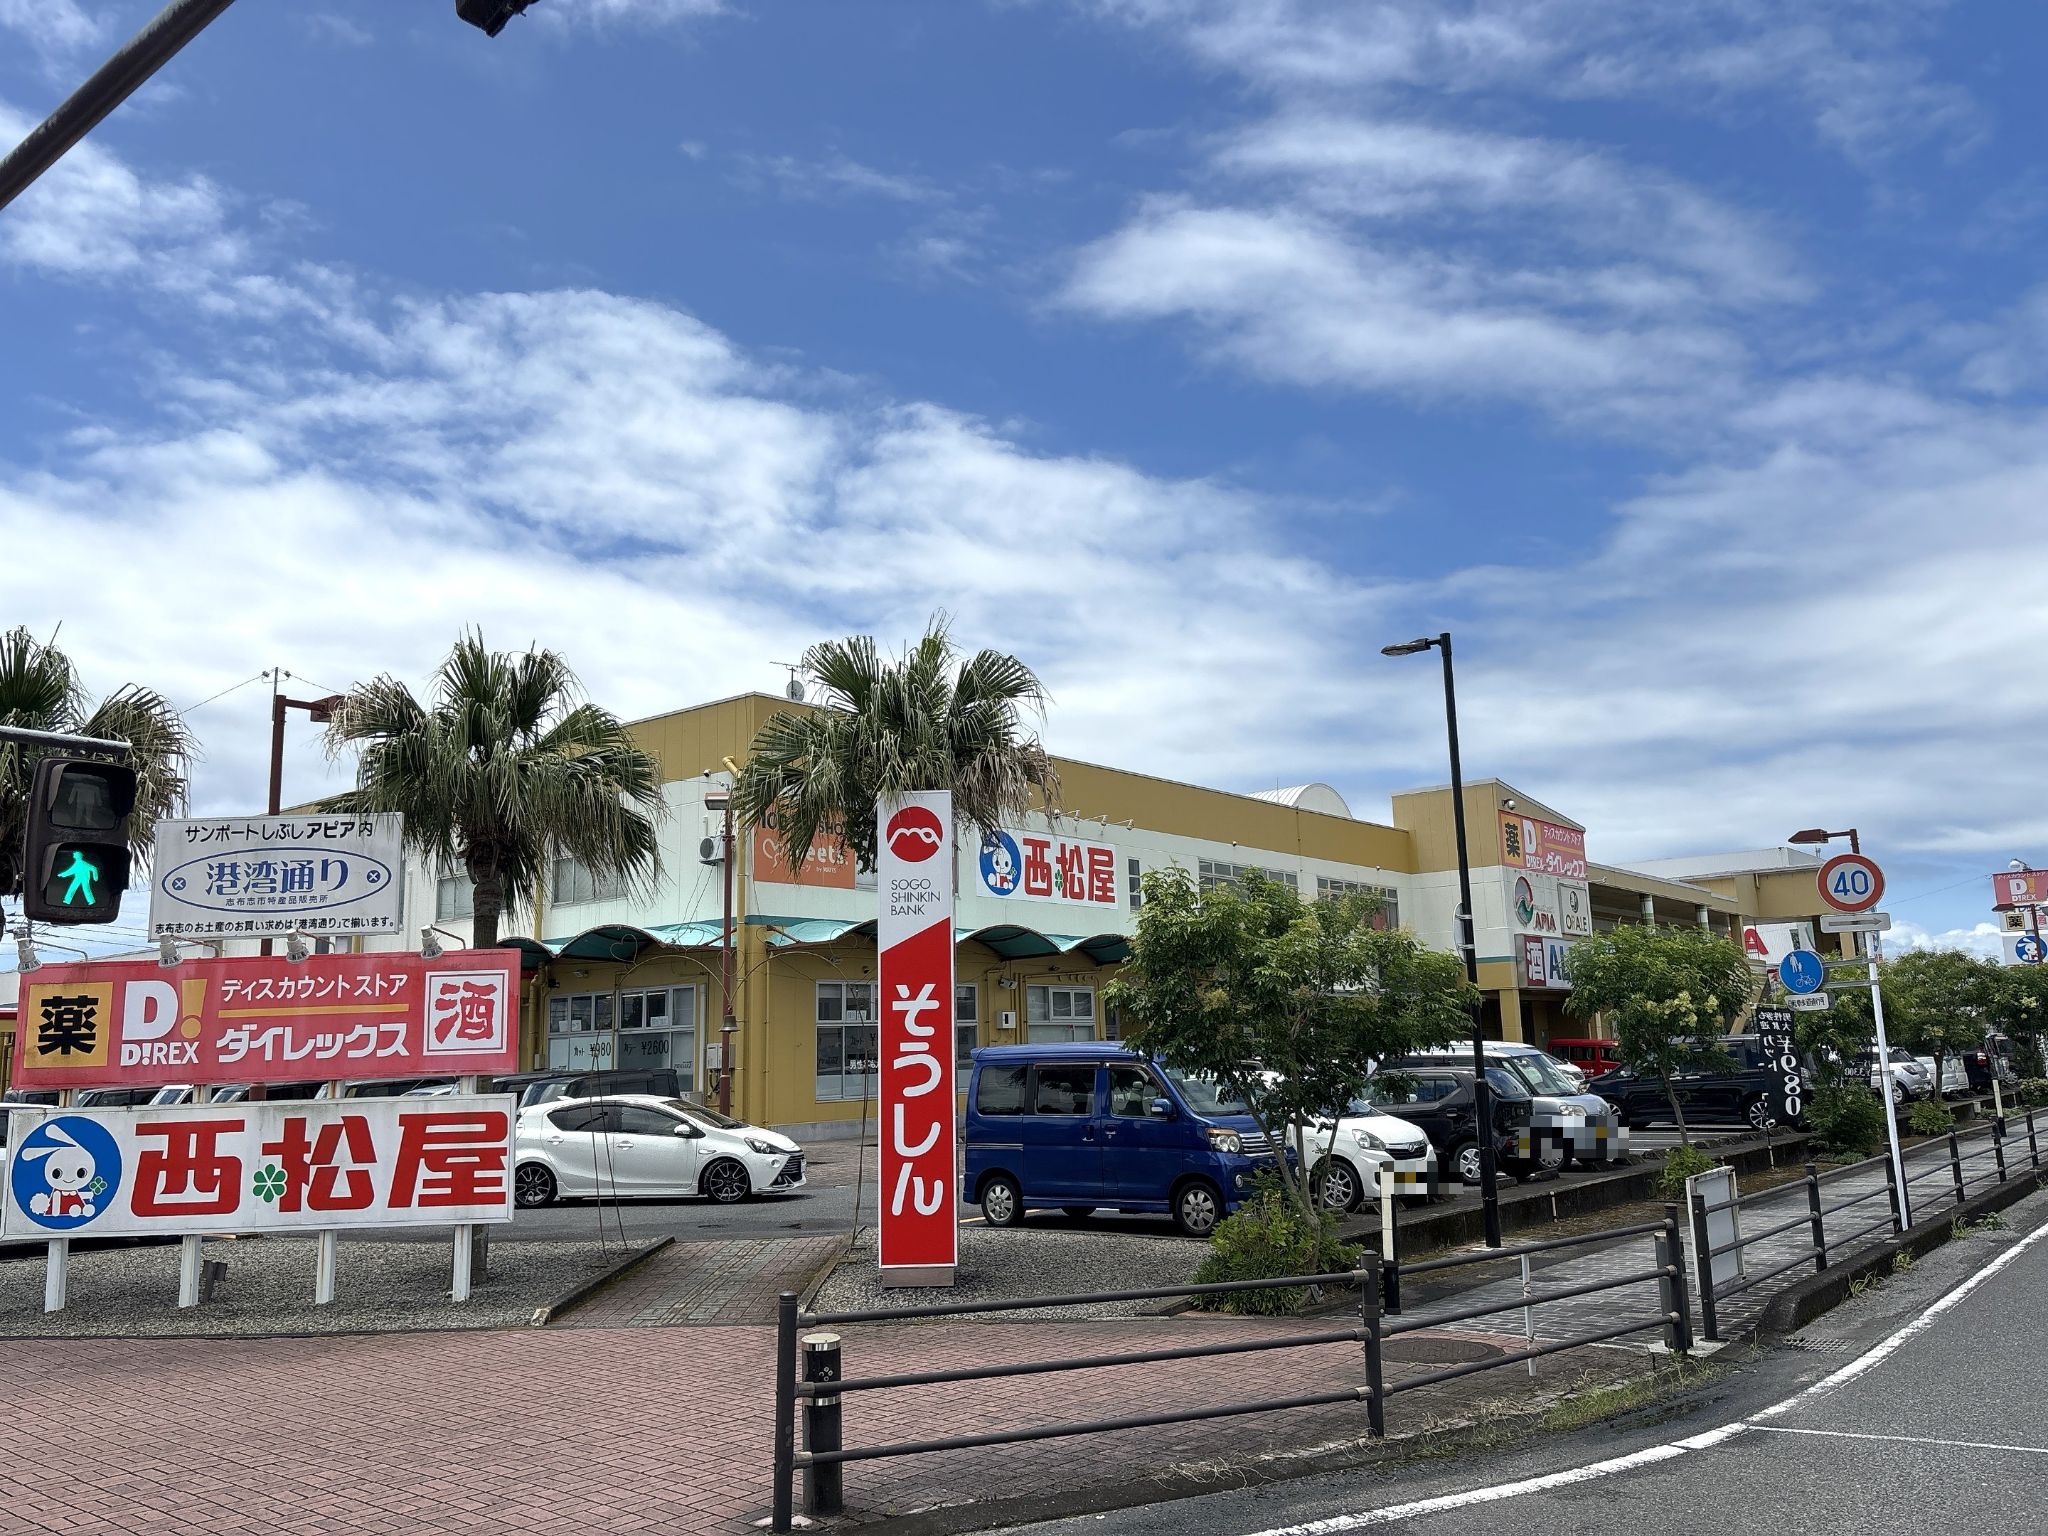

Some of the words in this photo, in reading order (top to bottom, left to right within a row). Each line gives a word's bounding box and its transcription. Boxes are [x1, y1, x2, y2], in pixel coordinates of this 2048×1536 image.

[185, 821, 374, 843] サンポートしぶしアピア内
[1504, 822, 1520, 858] 薬
[205, 858, 349, 896] 港湾通り
[1023, 837, 1116, 903] 西松屋
[1545, 851, 1586, 878] ダイレックス
[225, 895, 329, 907] 志布志市特産品販売所
[890, 878, 931, 890] SOGO
[890, 891, 942, 903] SHINKIN
[1833, 870, 1869, 896] 40
[890, 904, 926, 916] BANK
[1533, 912, 1557, 933] APIA
[1526, 941, 1545, 981] 酒
[1549, 944, 1571, 981] AL
[37, 995, 99, 1056] 薬
[434, 981, 498, 1045] 酒
[216, 1023, 410, 1063] ダイレックス
[641, 1039, 670, 1055] ¥2600
[891, 983, 944, 1216] そうしん
[130, 1110, 508, 1218] 西松屋
